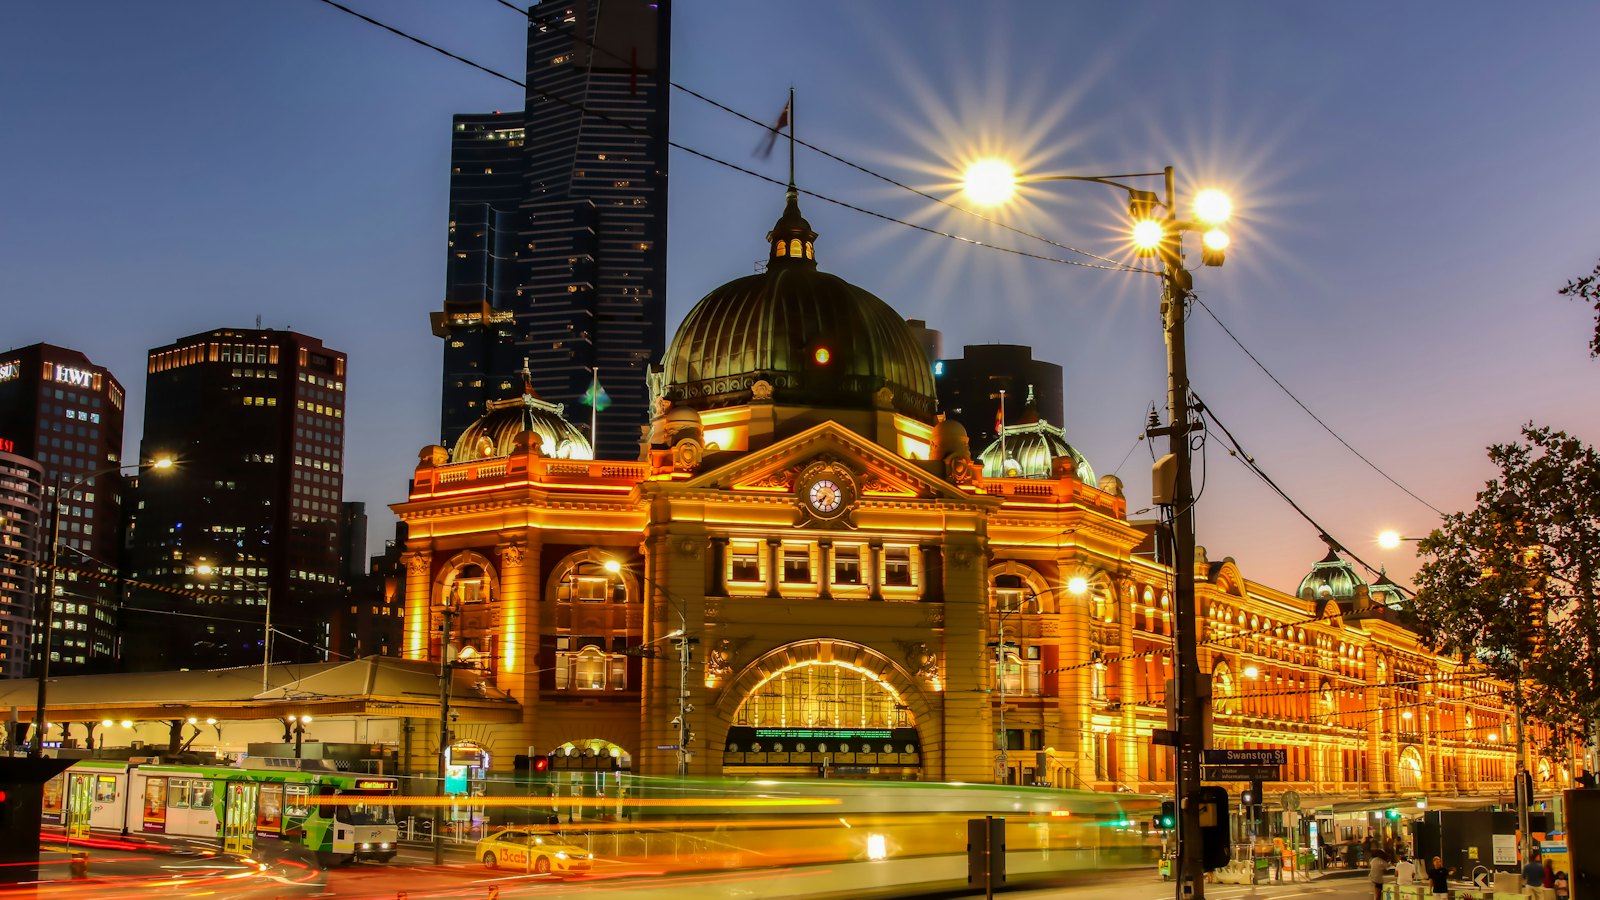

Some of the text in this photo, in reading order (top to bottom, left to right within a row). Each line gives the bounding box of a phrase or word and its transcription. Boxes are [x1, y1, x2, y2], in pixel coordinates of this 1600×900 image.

[56, 365, 93, 387] HWT
[1227, 750, 1285, 760] Swanston St
[500, 847, 528, 864] 13cab
